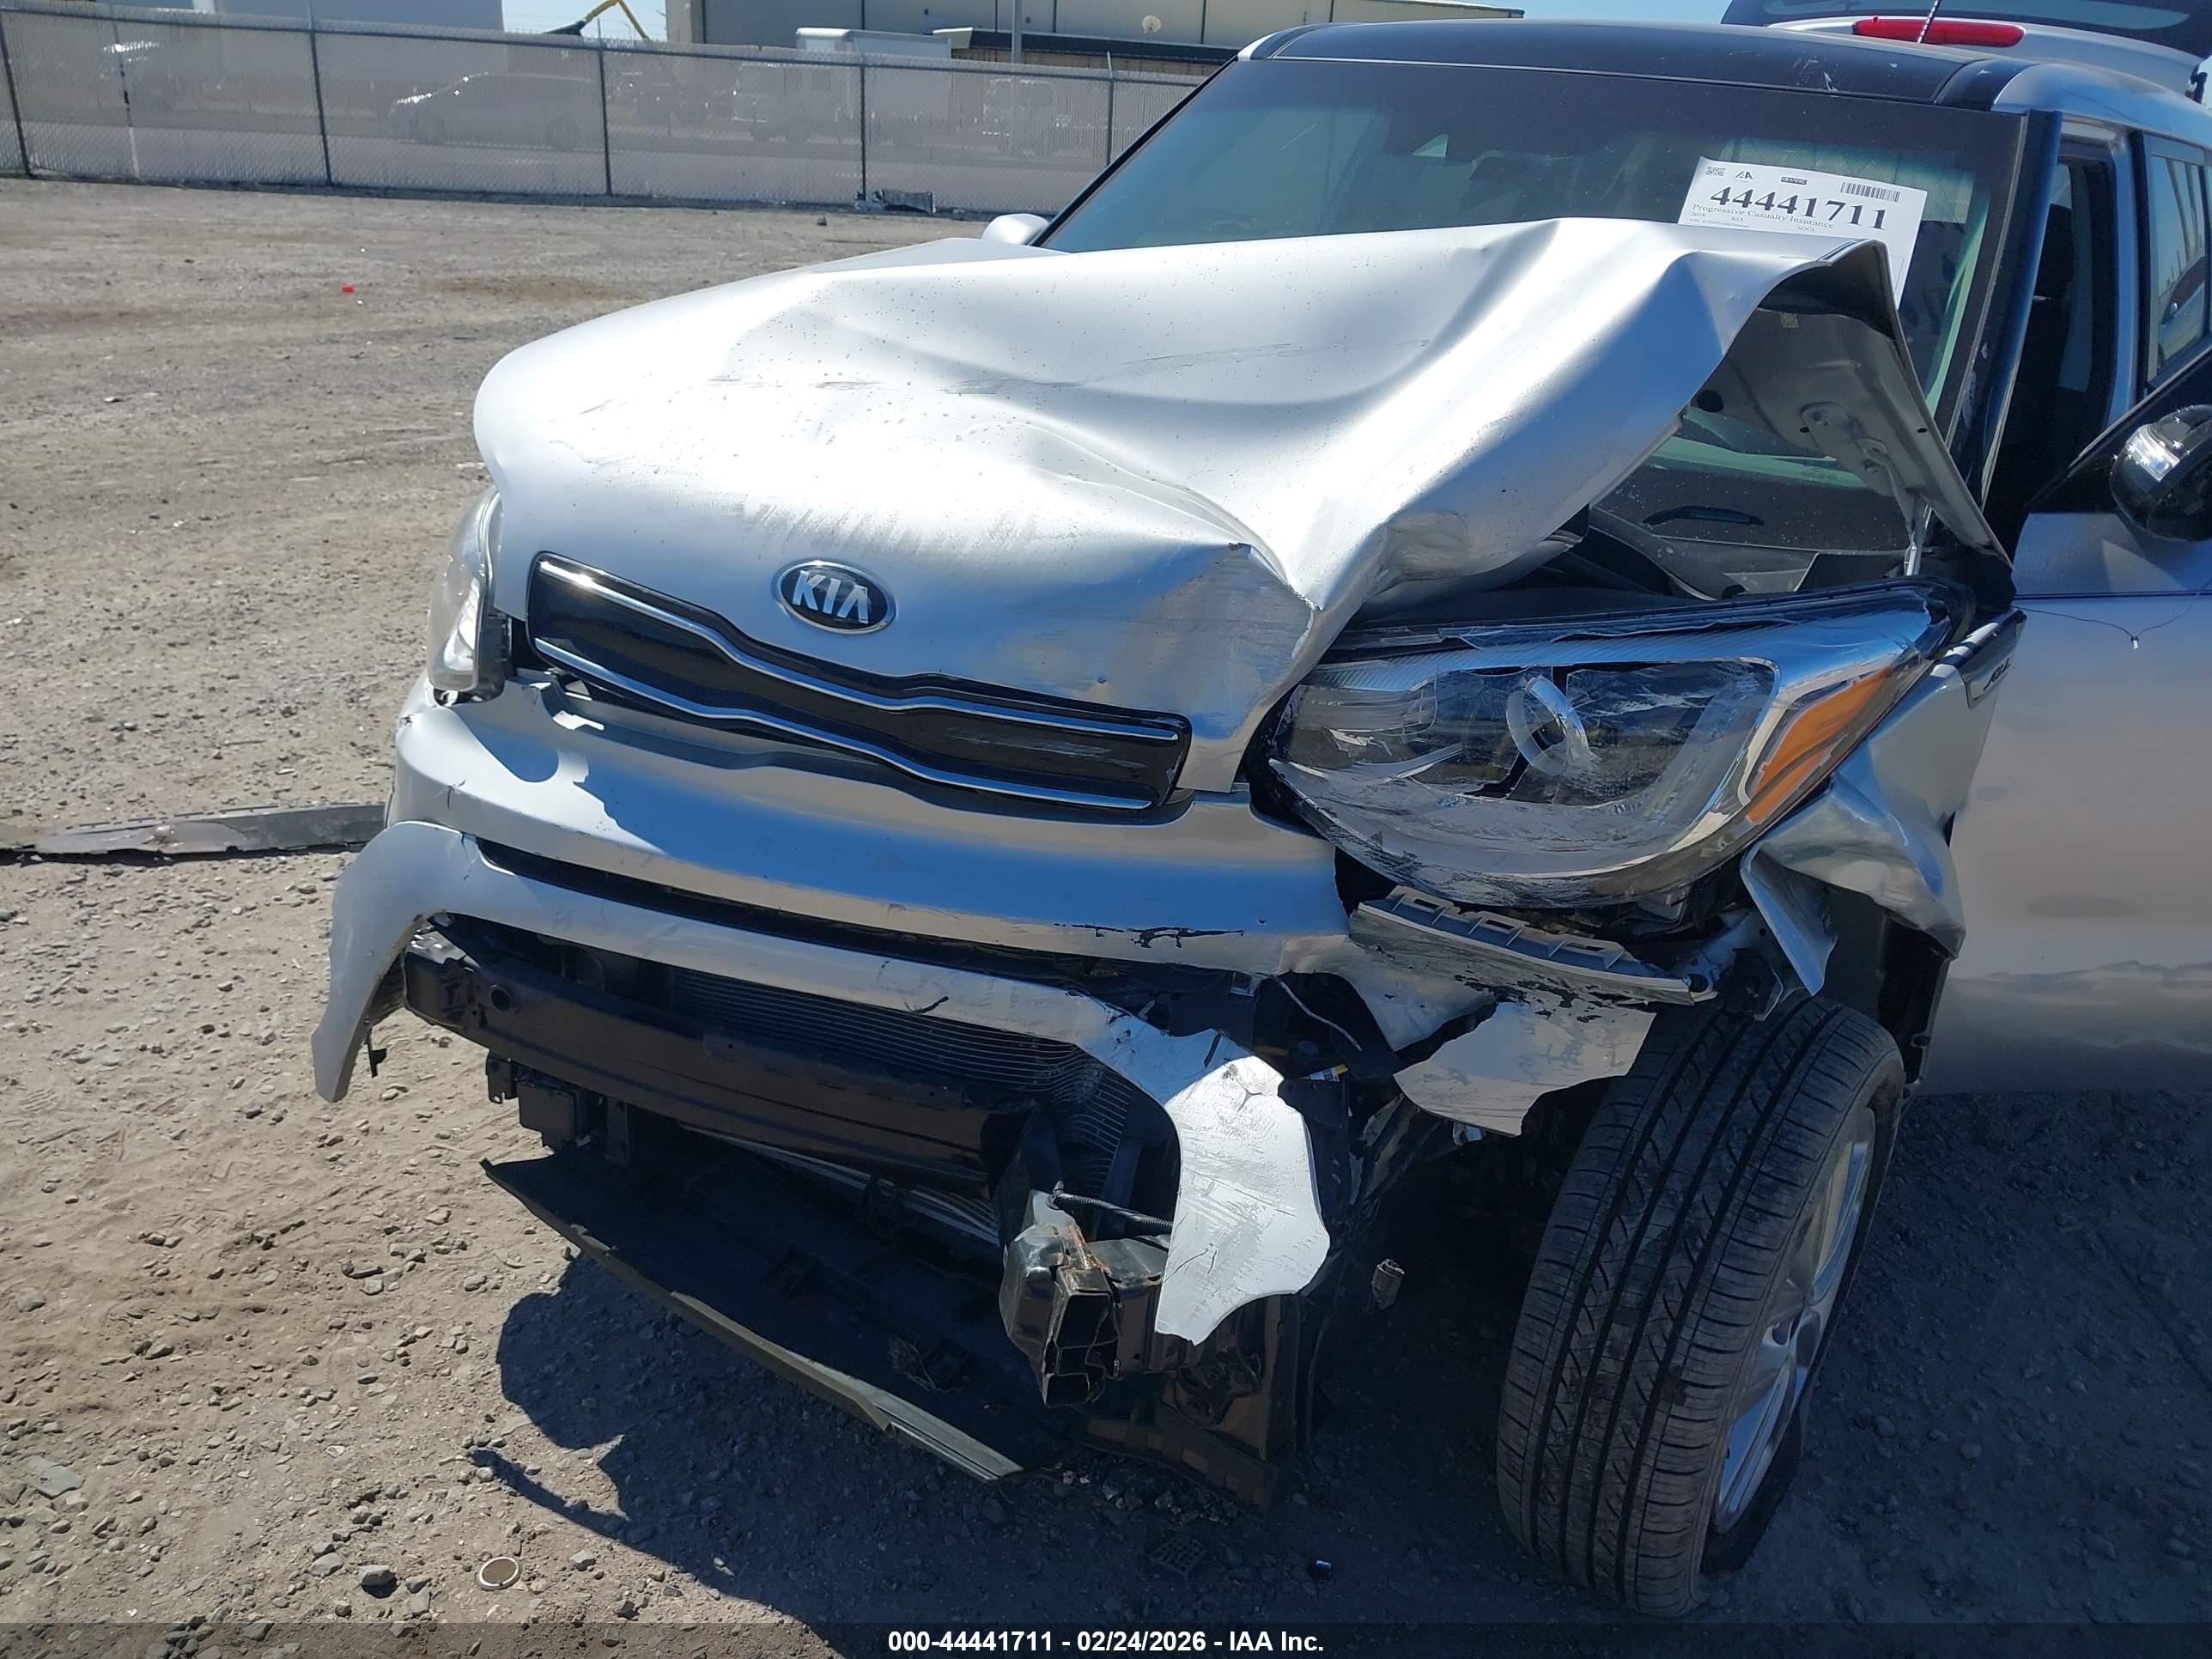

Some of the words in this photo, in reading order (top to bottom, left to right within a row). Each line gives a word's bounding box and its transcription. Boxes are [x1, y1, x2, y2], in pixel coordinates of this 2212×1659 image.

[1692, 203, 1746, 216] Progressive
[1747, 210, 1787, 222] Casualty
[1790, 215, 1835, 229] Insurance
[1710, 185, 1888, 230] 44441711
[792, 569, 869, 625] KIA
